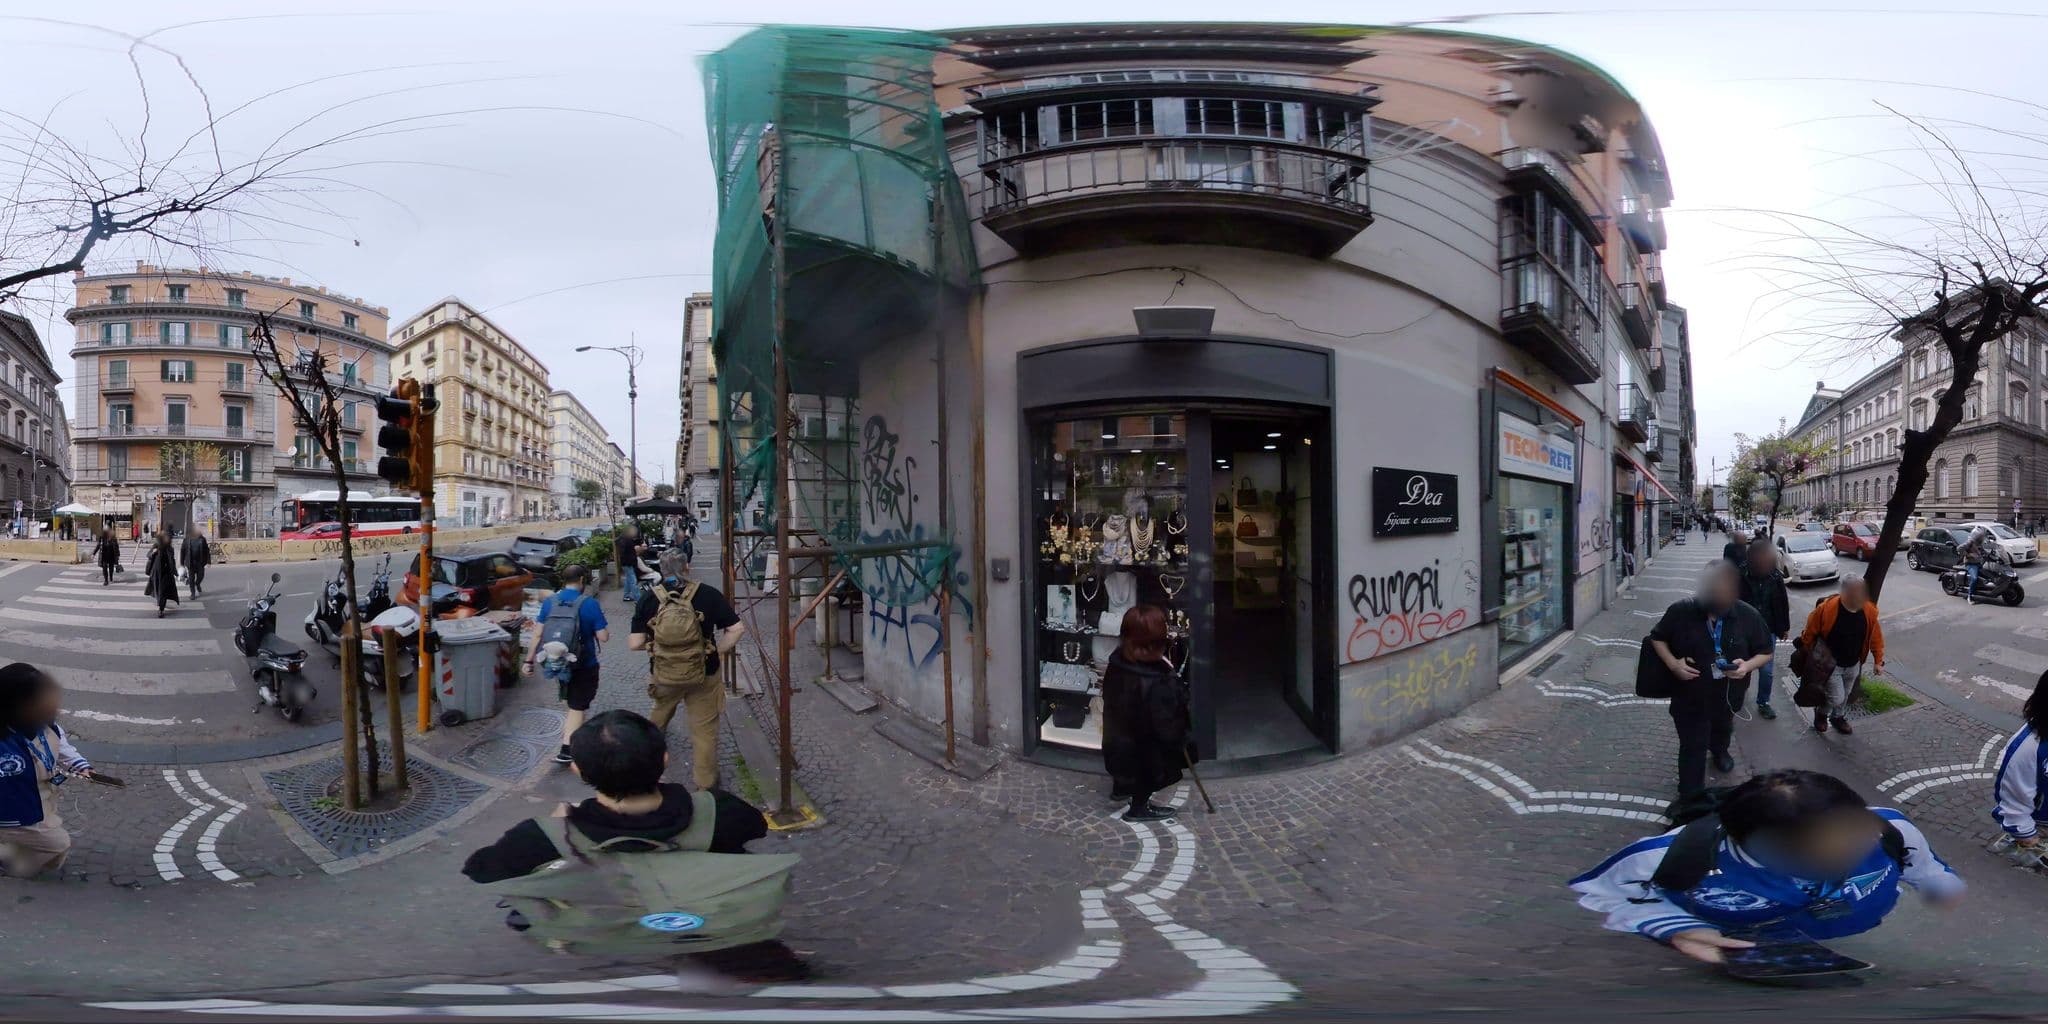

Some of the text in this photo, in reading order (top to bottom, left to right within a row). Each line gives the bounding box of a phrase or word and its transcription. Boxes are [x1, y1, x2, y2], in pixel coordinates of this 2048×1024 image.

[1504, 431, 1572, 471] TECNORETE
[1398, 475, 1444, 506] Dea
[1383, 512, 1411, 532] bijoux
[1421, 516, 1453, 524] accessori
[1349, 559, 1443, 623] RUMORI
